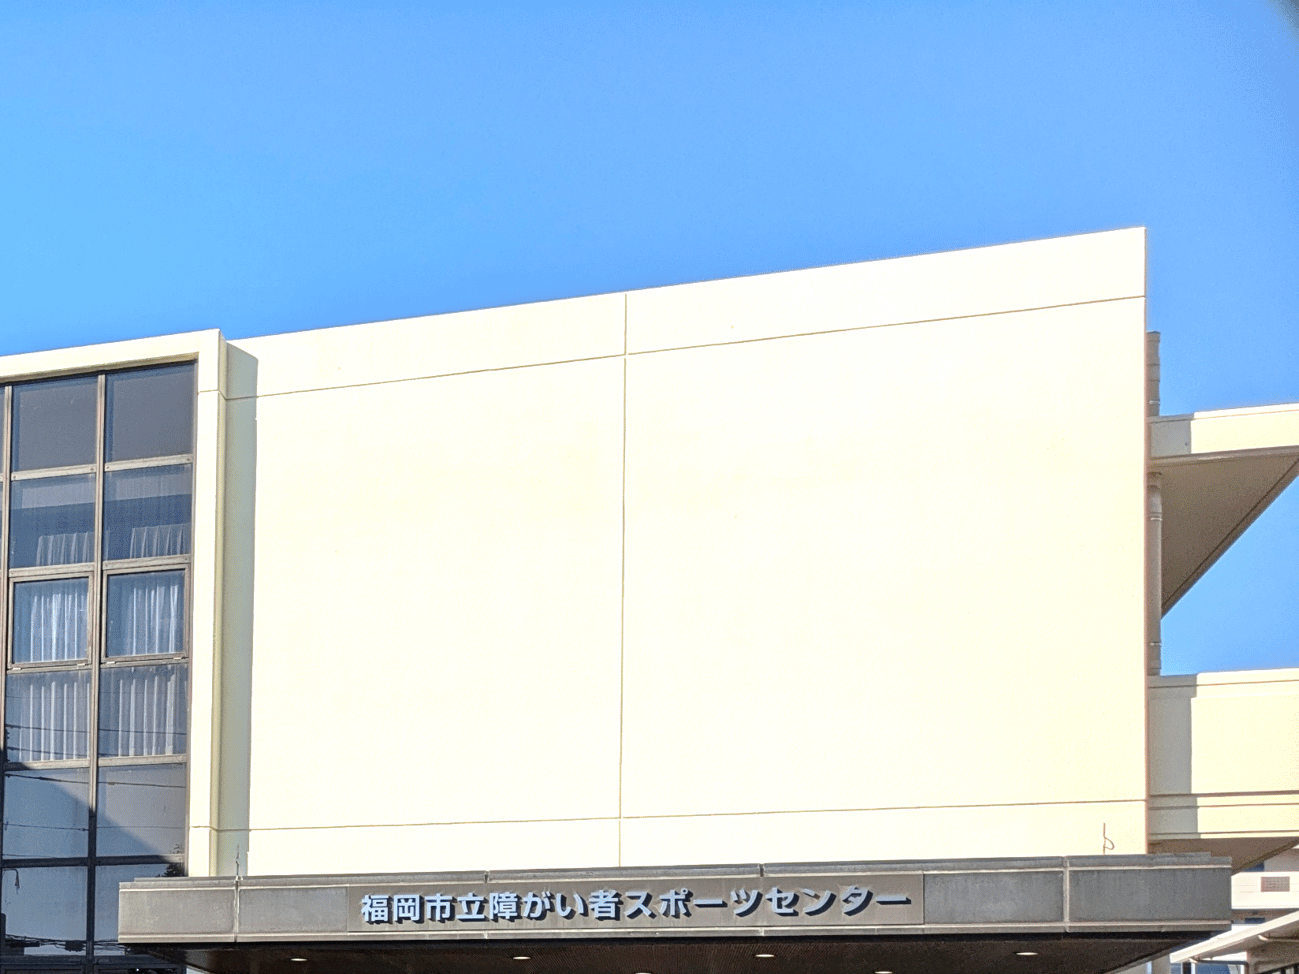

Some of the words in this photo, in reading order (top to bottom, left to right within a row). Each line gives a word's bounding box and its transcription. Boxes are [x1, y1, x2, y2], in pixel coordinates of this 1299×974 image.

[361, 886, 911, 923] 福岡市立障がい者スポーツセンター
